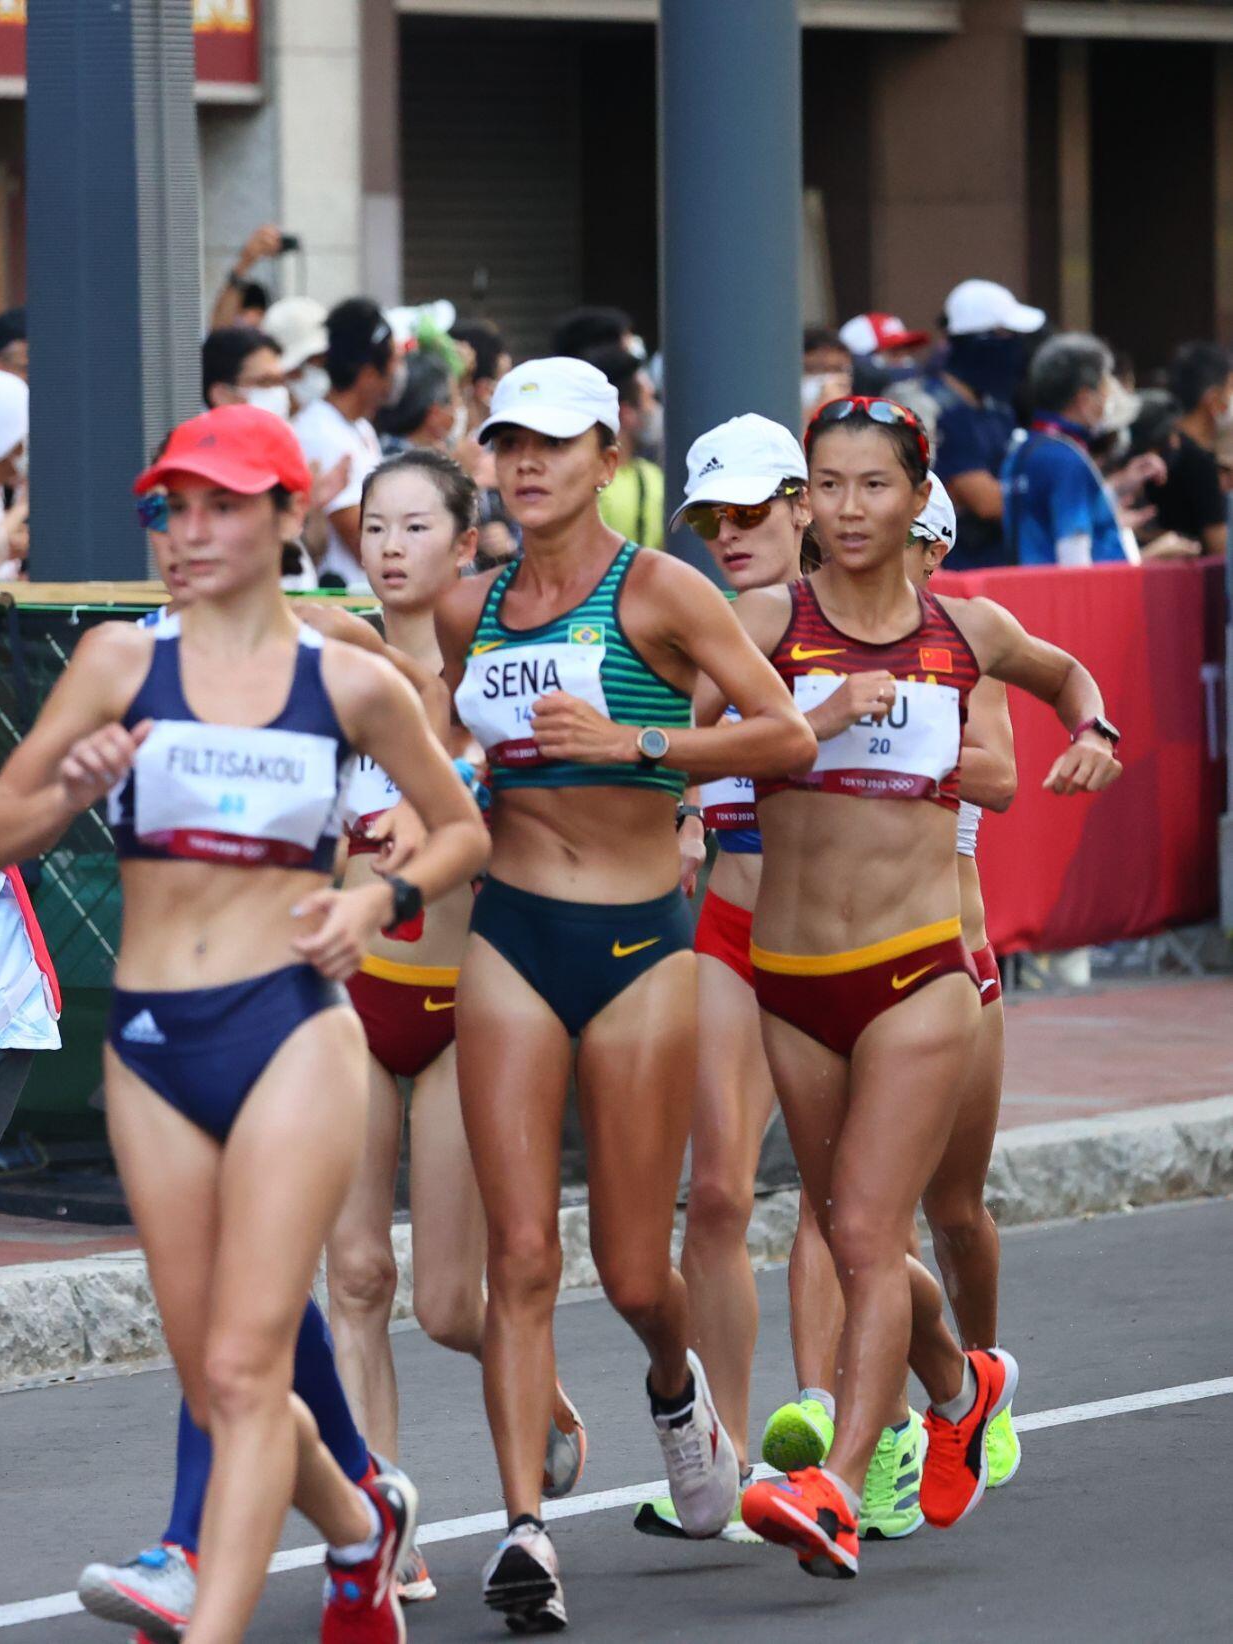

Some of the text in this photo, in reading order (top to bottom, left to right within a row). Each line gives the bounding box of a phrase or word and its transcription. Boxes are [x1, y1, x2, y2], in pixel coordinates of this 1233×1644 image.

[483, 659, 561, 699] SENA
[869, 738, 891, 755] 20
[167, 747, 304, 784] FILTISAKOU
[841, 777, 868, 788] TOKYO
[716, 812, 738, 821] TOKYO
